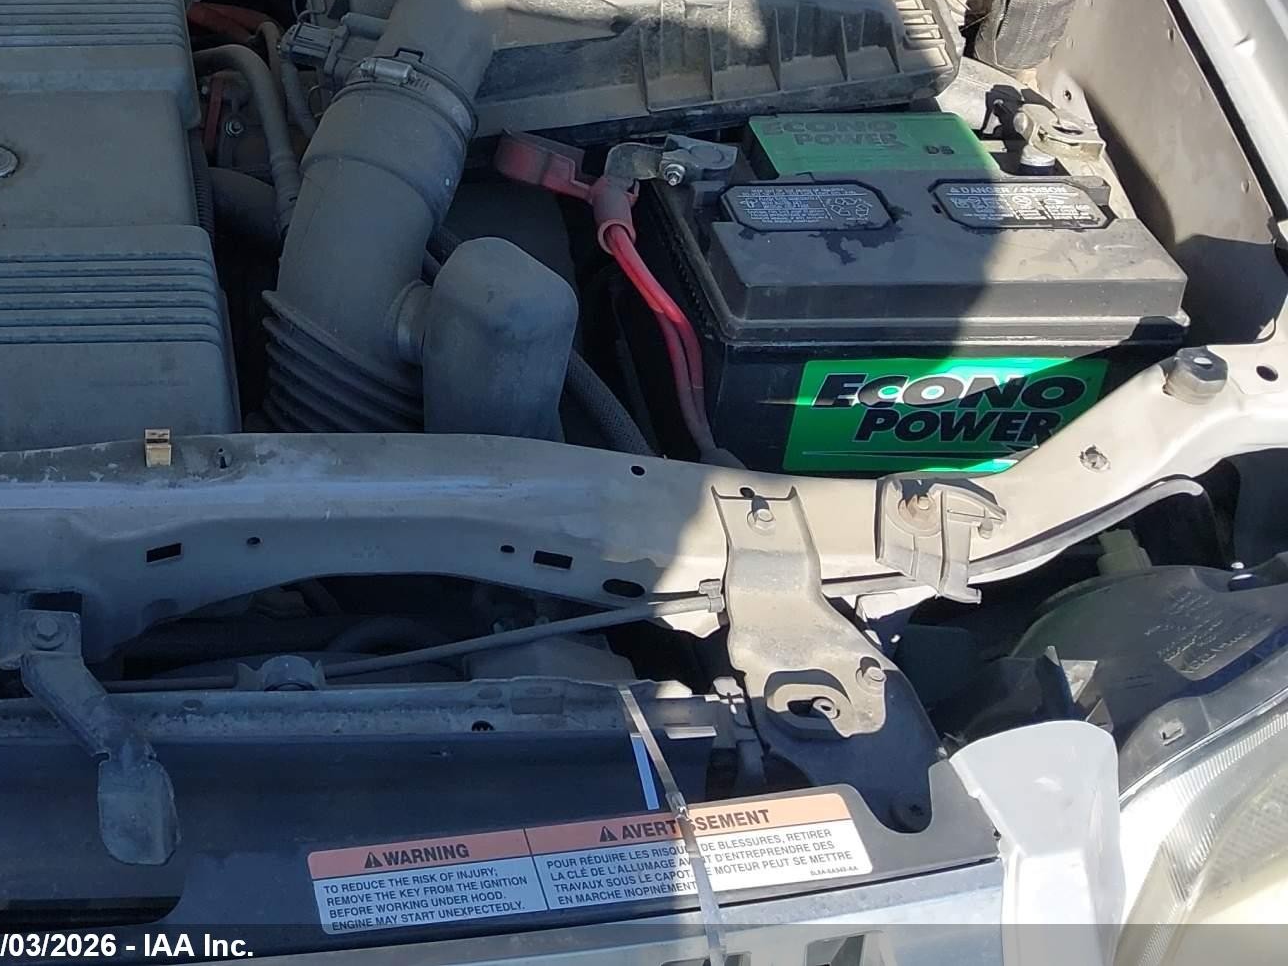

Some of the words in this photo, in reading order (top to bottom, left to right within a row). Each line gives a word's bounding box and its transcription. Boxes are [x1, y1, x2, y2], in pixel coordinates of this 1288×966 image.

[763, 120, 898, 134] ECONO
[794, 133, 899, 145] POWER
[960, 186, 1010, 194] DANGER
[1020, 186, 1067, 194] POISON
[812, 372, 1088, 410] ECONO
[852, 409, 1063, 443] POWER
[622, 809, 769, 840] AVERTSSEMENT
[383, 843, 470, 867] WARNING
[546, 858, 577, 869] POUR
[579, 850, 627, 866] RÉDUIRE
[628, 850, 650, 860] LES
[652, 845, 689, 857] RISQU
[700, 841, 716, 852] DE
[718, 835, 786, 850] BLESSURES,
[787, 828, 833, 842] RETIRER
[550, 872, 565, 882] LA
[568, 867, 589, 880] CLÉ
[591, 867, 606, 876] DE
[607, 859, 676, 875] L'ALLUMAGE
[715, 844, 811, 863] D'ENTREPRENDRE
[813, 840, 835, 851] DES
[323, 884, 339, 895] TO
[341, 879, 386, 893] REDUCE
[388, 876, 410, 887] THE
[412, 873, 438, 884] RISK
[439, 871, 455, 882] OF
[554, 880, 602, 893] TRAVAUX
[605, 876, 636, 887] SOUS
[639, 874, 652, 883] LE
[655, 869, 694, 882] CAPOT.
[714, 860, 761, 875] MOTEUR
[762, 857, 791, 869] PEUT
[792, 855, 808, 865] SE
[810, 850, 853, 864] METTRE
[327, 892, 373, 907] REMOVE
[375, 890, 397, 901] THE
[399, 887, 421, 898] KEY
[423, 884, 455, 895] FROM
[456, 881, 478, 892] THE
[480, 876, 528, 890] IGNITION
[329, 905, 373, 919] BEFORE
[375, 899, 429, 914] WORKING
[431, 895, 469, 908] UNDER
[471, 890, 506, 903] HOOD.
[558, 895, 574, 906] EN
[576, 889, 622, 903] MARCHE
[332, 917, 373, 931] ENGINE
[375, 913, 398, 925] MAY
[401, 910, 437, 923] START
[438, 900, 526, 919] UNEXPECTEDLY.
